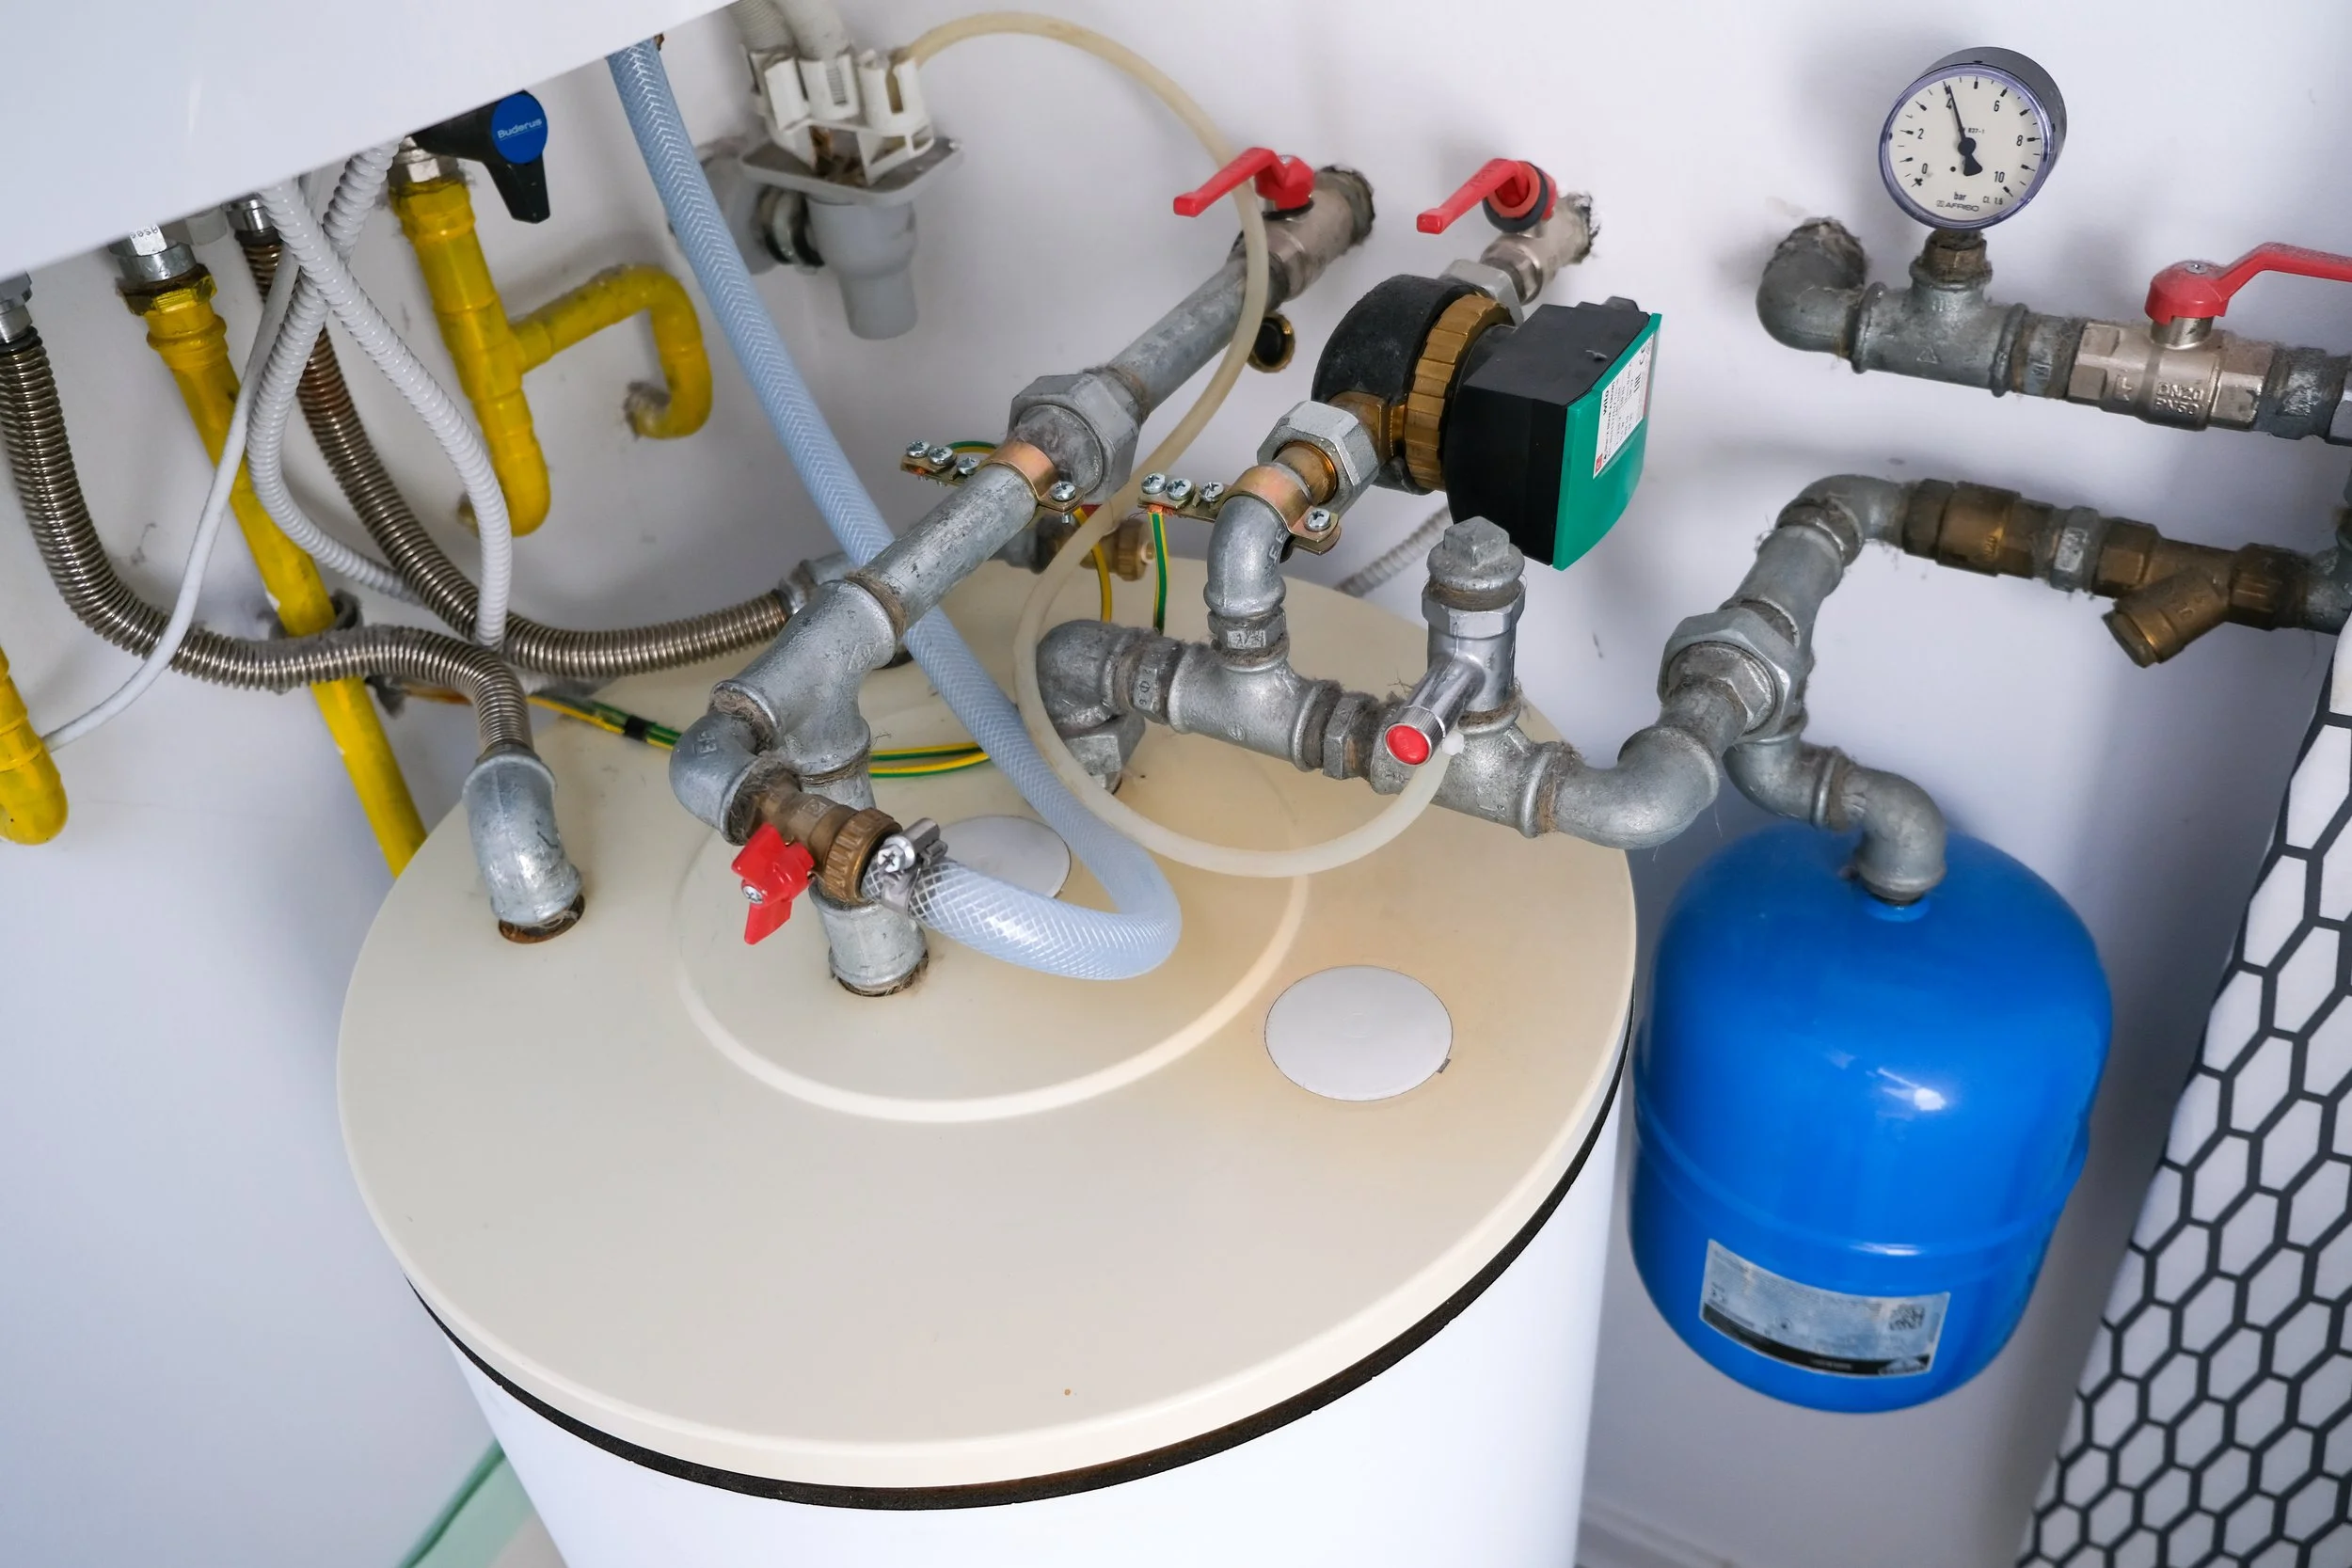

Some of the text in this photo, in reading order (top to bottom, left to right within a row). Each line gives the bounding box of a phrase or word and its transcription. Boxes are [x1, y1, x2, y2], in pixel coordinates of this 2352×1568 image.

[1994, 100, 2000, 112] 6
[497, 118, 543, 139] Buderus
[1917, 128, 1924, 139] 2
[2016, 135, 2023, 147] 8
[1921, 163, 1928, 175] 0
[1994, 171, 2005, 183] 10
[1953, 191, 1966, 201] bar
[1945, 202, 1980, 212] AFRISO
